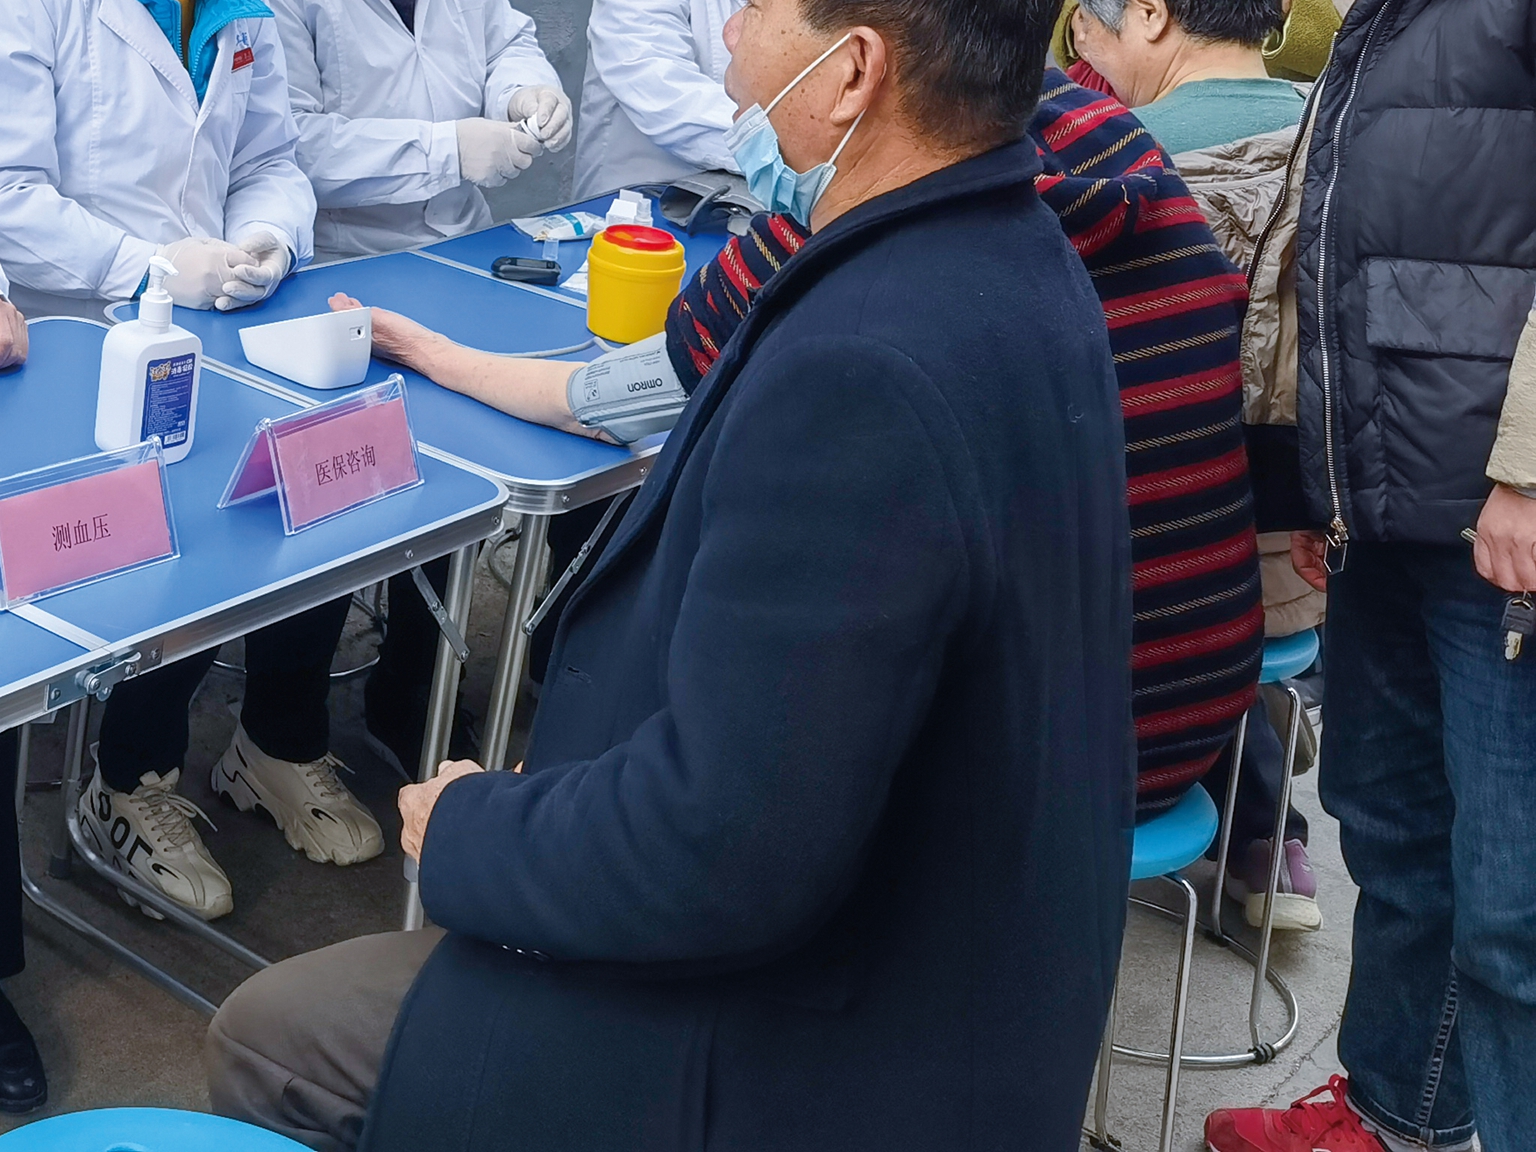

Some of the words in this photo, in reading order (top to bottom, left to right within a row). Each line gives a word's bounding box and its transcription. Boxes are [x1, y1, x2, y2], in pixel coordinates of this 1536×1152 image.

[315, 444, 376, 486] 医保咨询
[51, 514, 111, 552] 测血压
